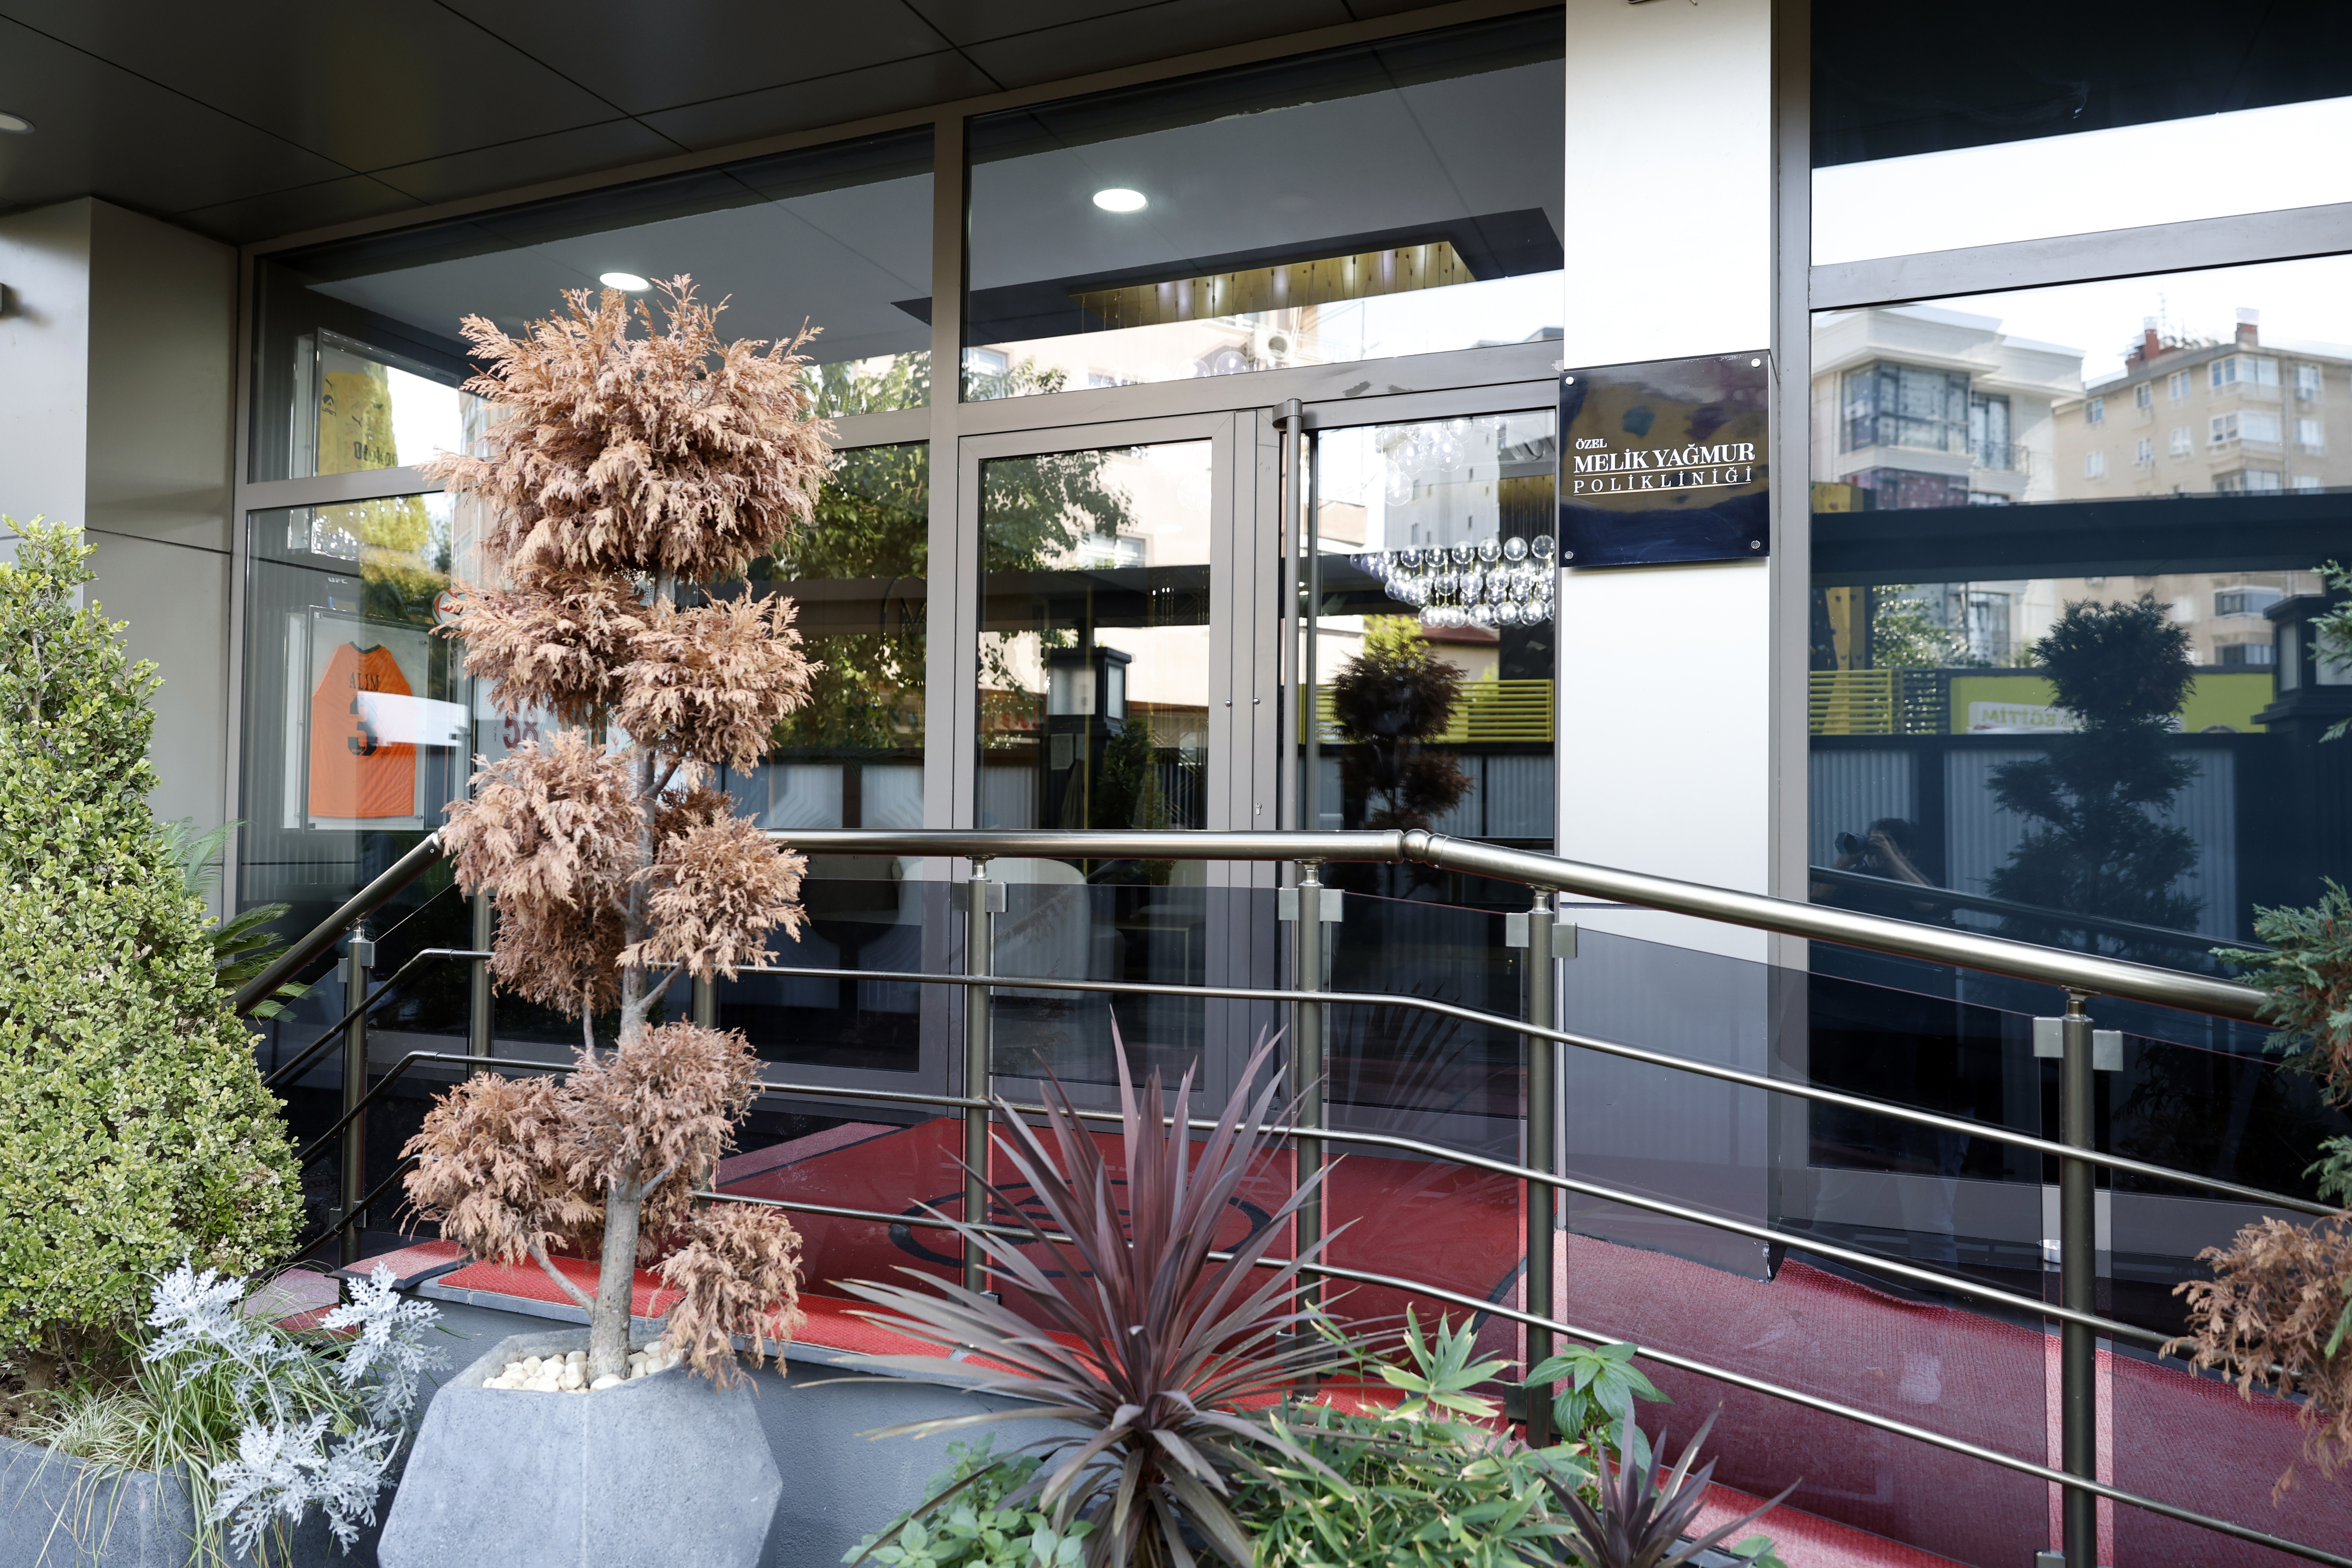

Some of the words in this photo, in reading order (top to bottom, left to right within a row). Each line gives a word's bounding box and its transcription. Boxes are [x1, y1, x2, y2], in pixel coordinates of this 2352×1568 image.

[1573, 448, 1650, 473] MELİK
[1652, 443, 1755, 467] YAĞMUR
[1575, 438, 1607, 450] ÖZEL
[1573, 466, 1752, 493] POLİKLİNİĞİ
[349, 672, 379, 691] ALIM
[348, 696, 378, 756] 3
[503, 701, 540, 750] 58
